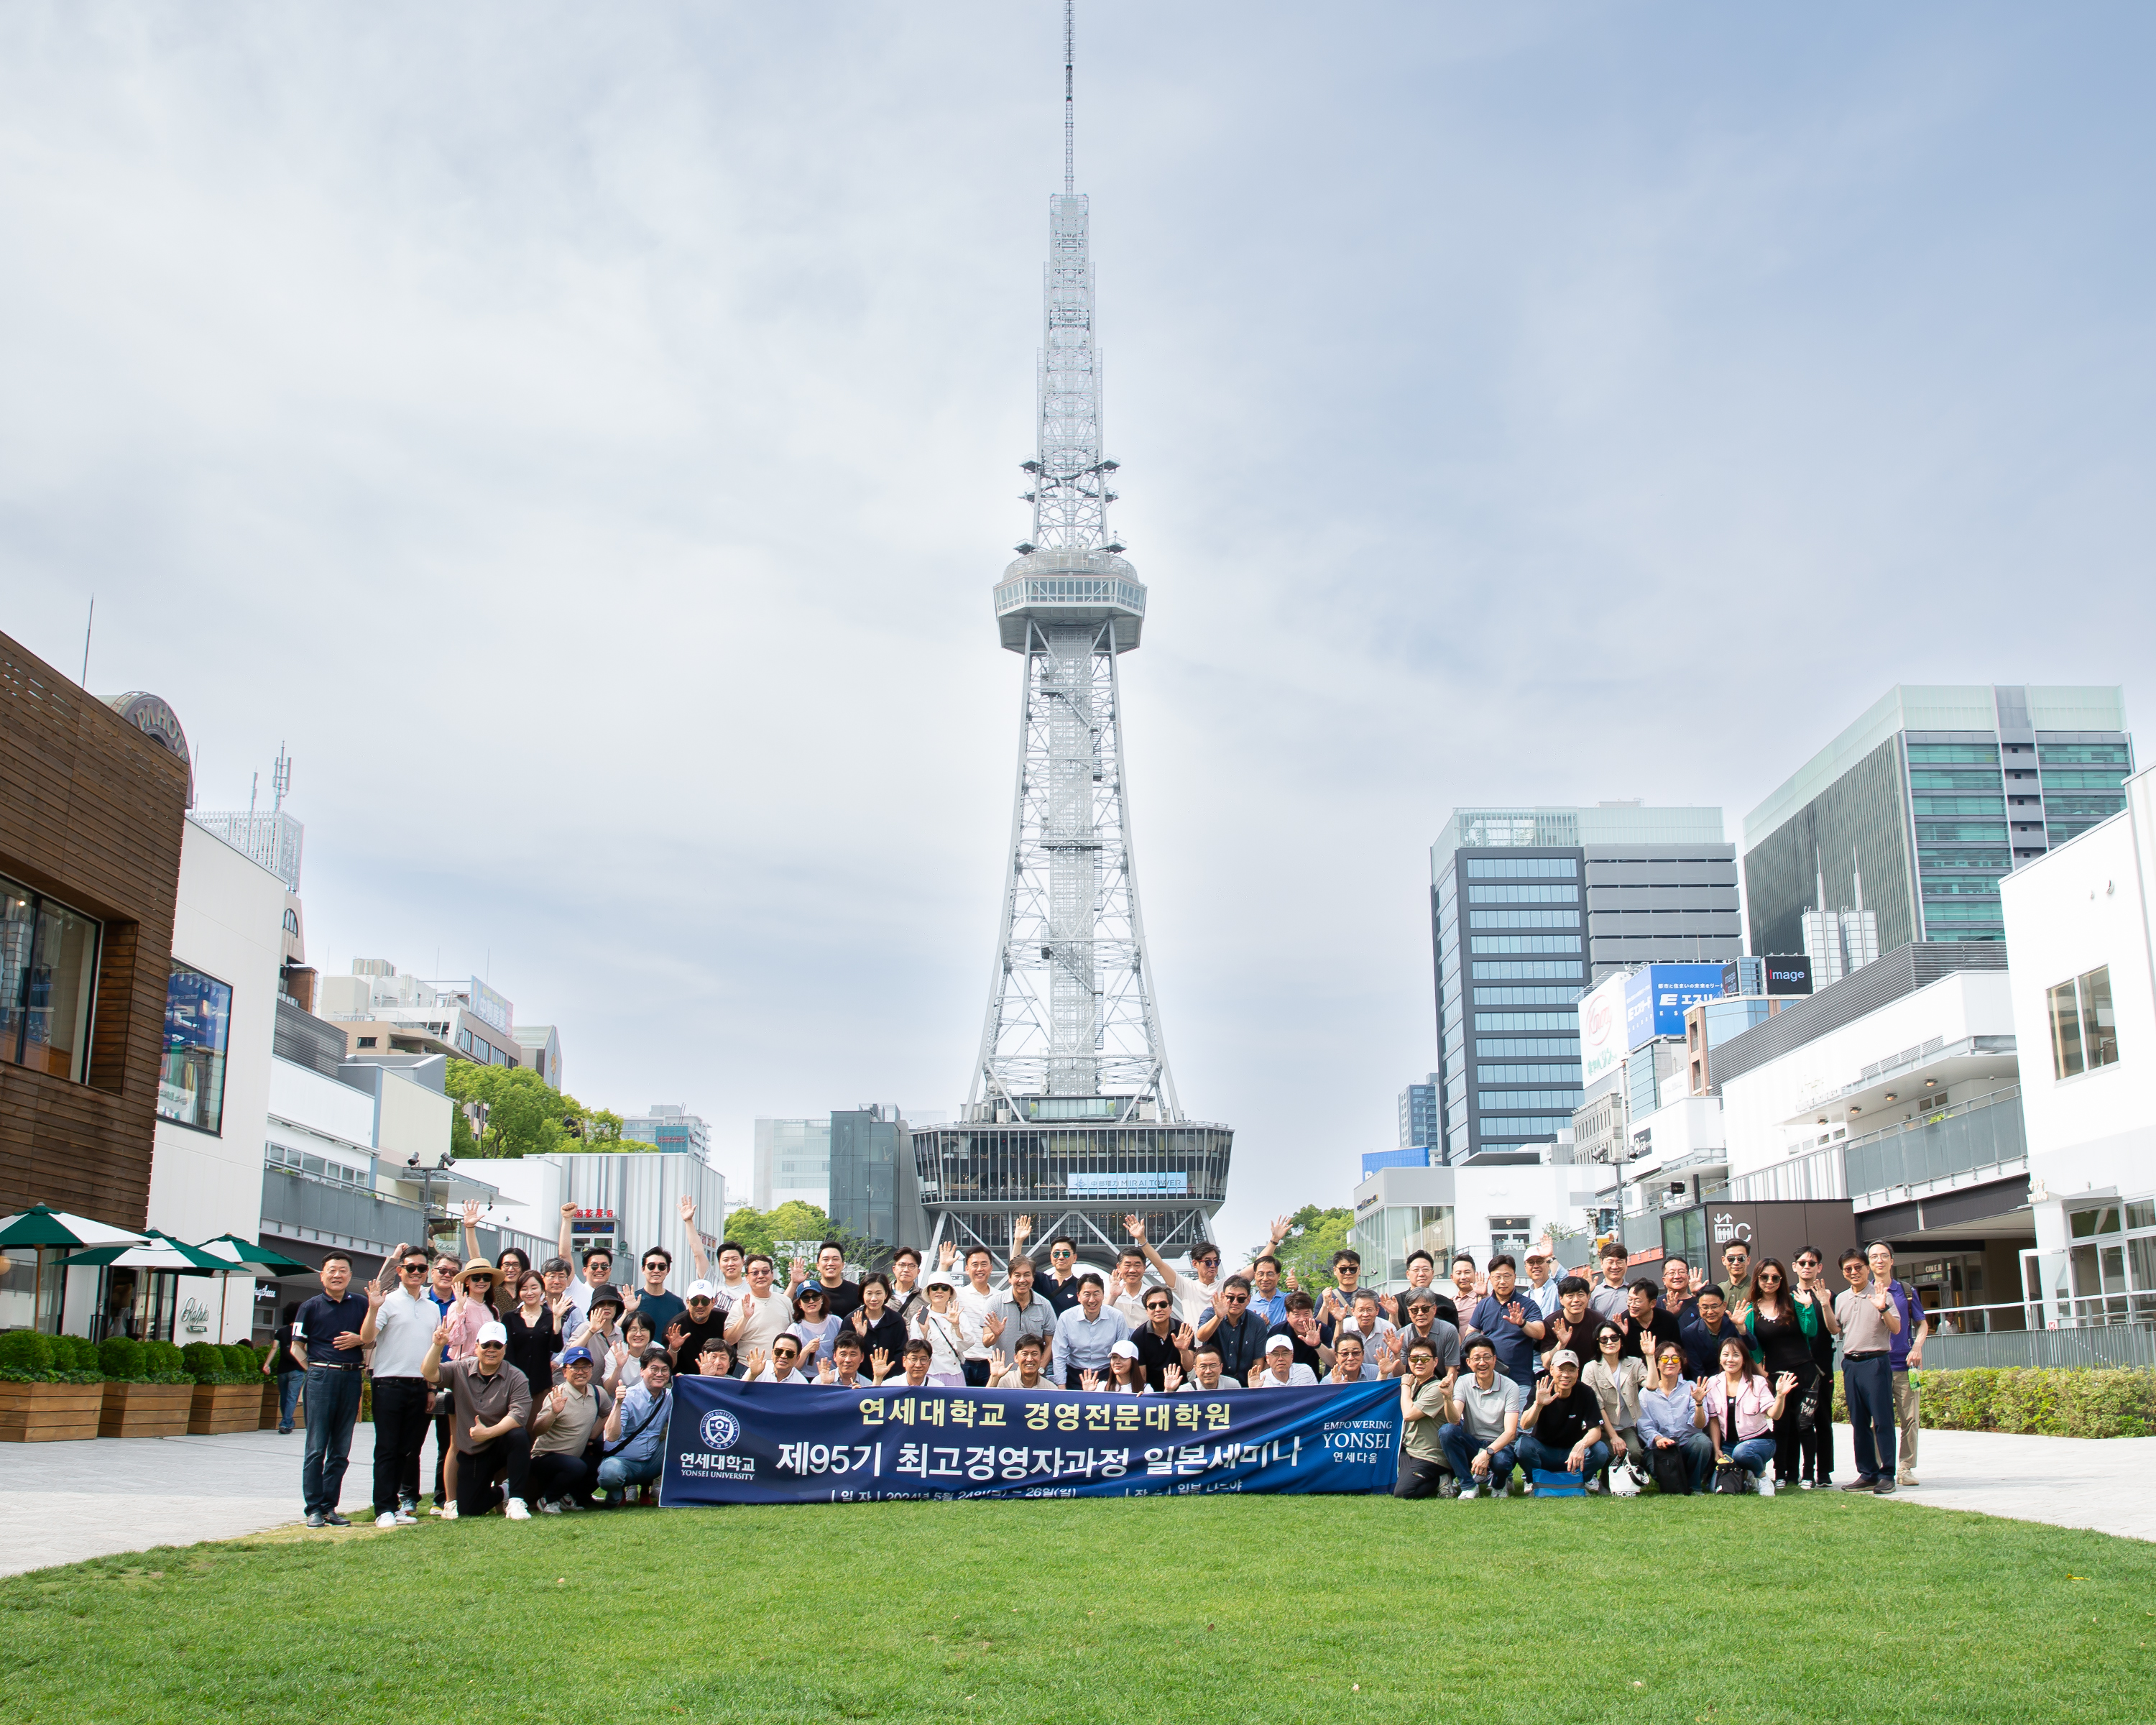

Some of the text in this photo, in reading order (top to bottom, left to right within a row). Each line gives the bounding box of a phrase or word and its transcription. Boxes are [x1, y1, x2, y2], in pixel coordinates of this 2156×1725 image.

[1769, 969, 1805, 982] Image
[1734, 1223, 1752, 1243] C
[860, 1397, 1230, 1432] 연세대학교 경영전문대학원
[1323, 1420, 1393, 1430] EMPOWERING
[1322, 1432, 1391, 1449] YONSEI
[680, 1453, 755, 1472] 연세대학교
[776, 1436, 1302, 1481] 제95기 최고경영자과정 일본세미나
[1333, 1451, 1378, 1463] 연세다움
[681, 1469, 755, 1481] YONSEI UNIVERSITY
